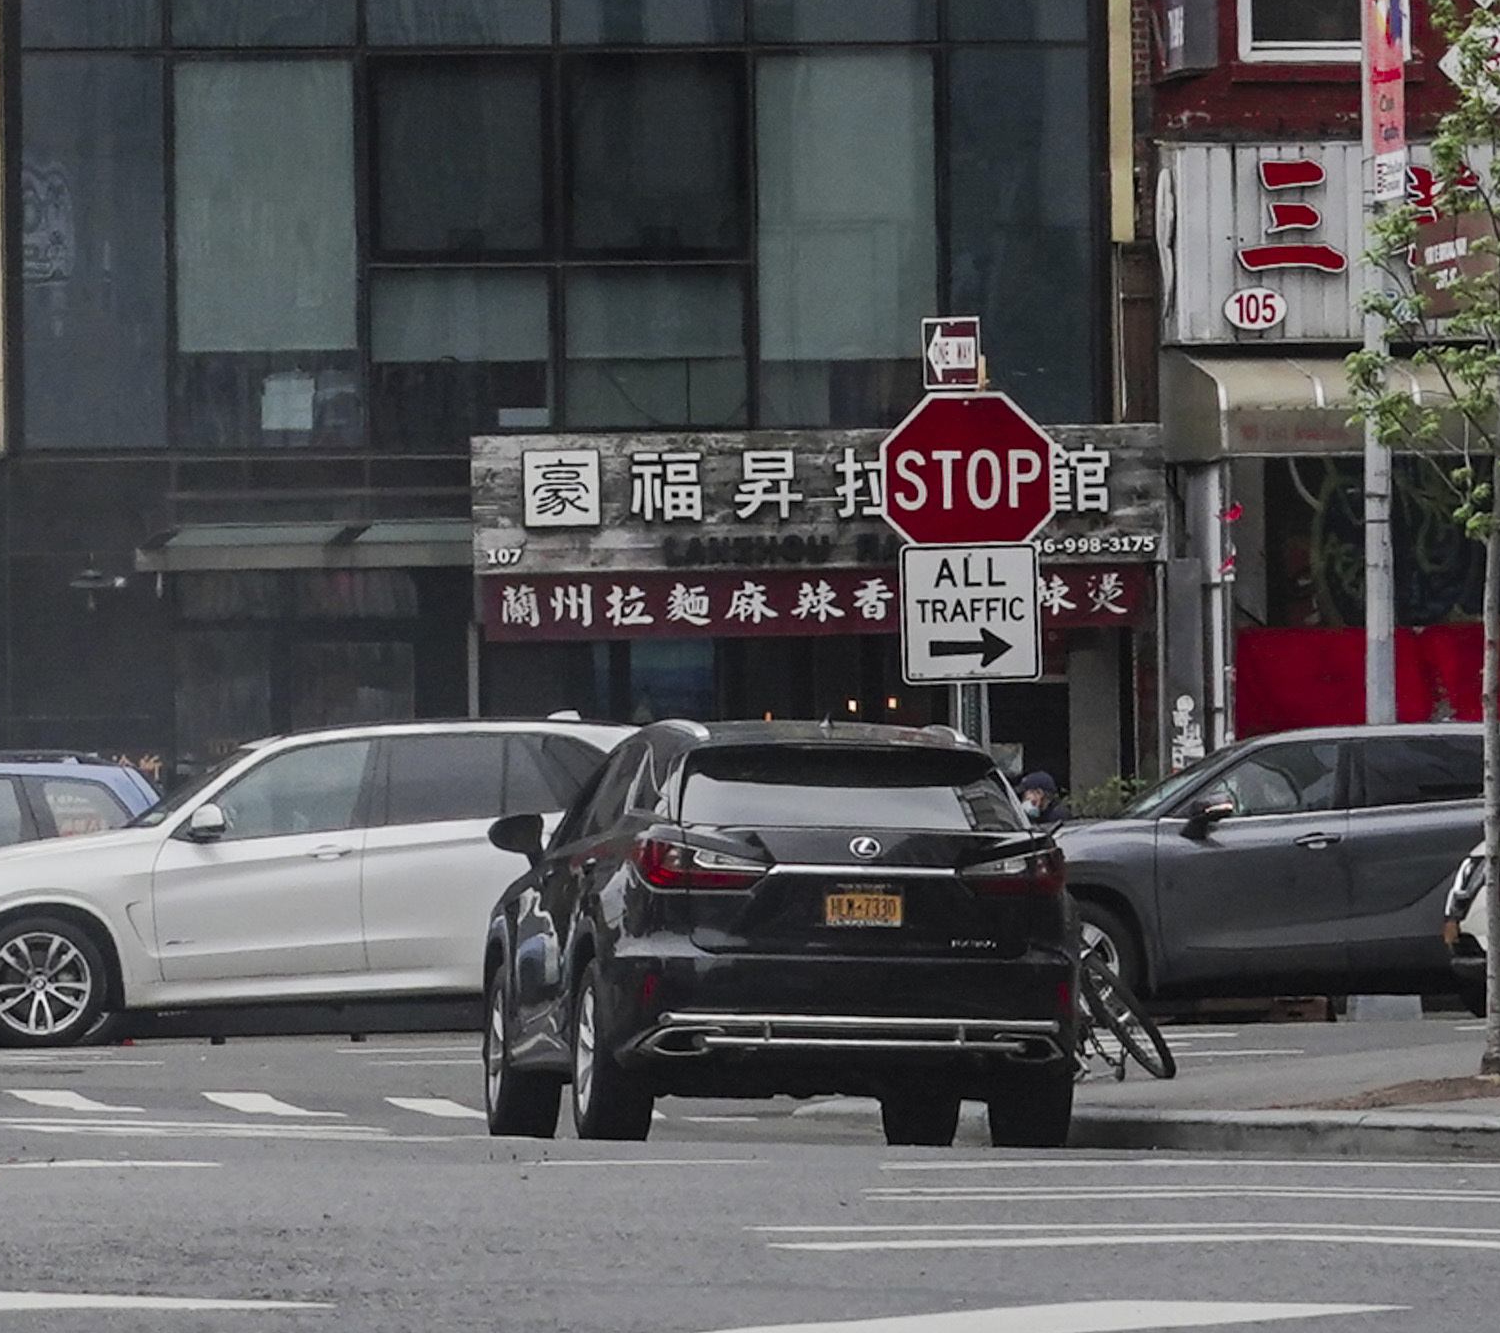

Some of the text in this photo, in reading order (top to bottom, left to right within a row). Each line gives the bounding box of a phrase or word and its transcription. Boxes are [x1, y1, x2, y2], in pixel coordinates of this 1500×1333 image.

[1234, 293, 1277, 323] 105
[895, 448, 1043, 512] STOP
[486, 547, 522, 566] 107
[933, 556, 1008, 590] ALL
[916, 594, 1026, 625] TRAFFIC
